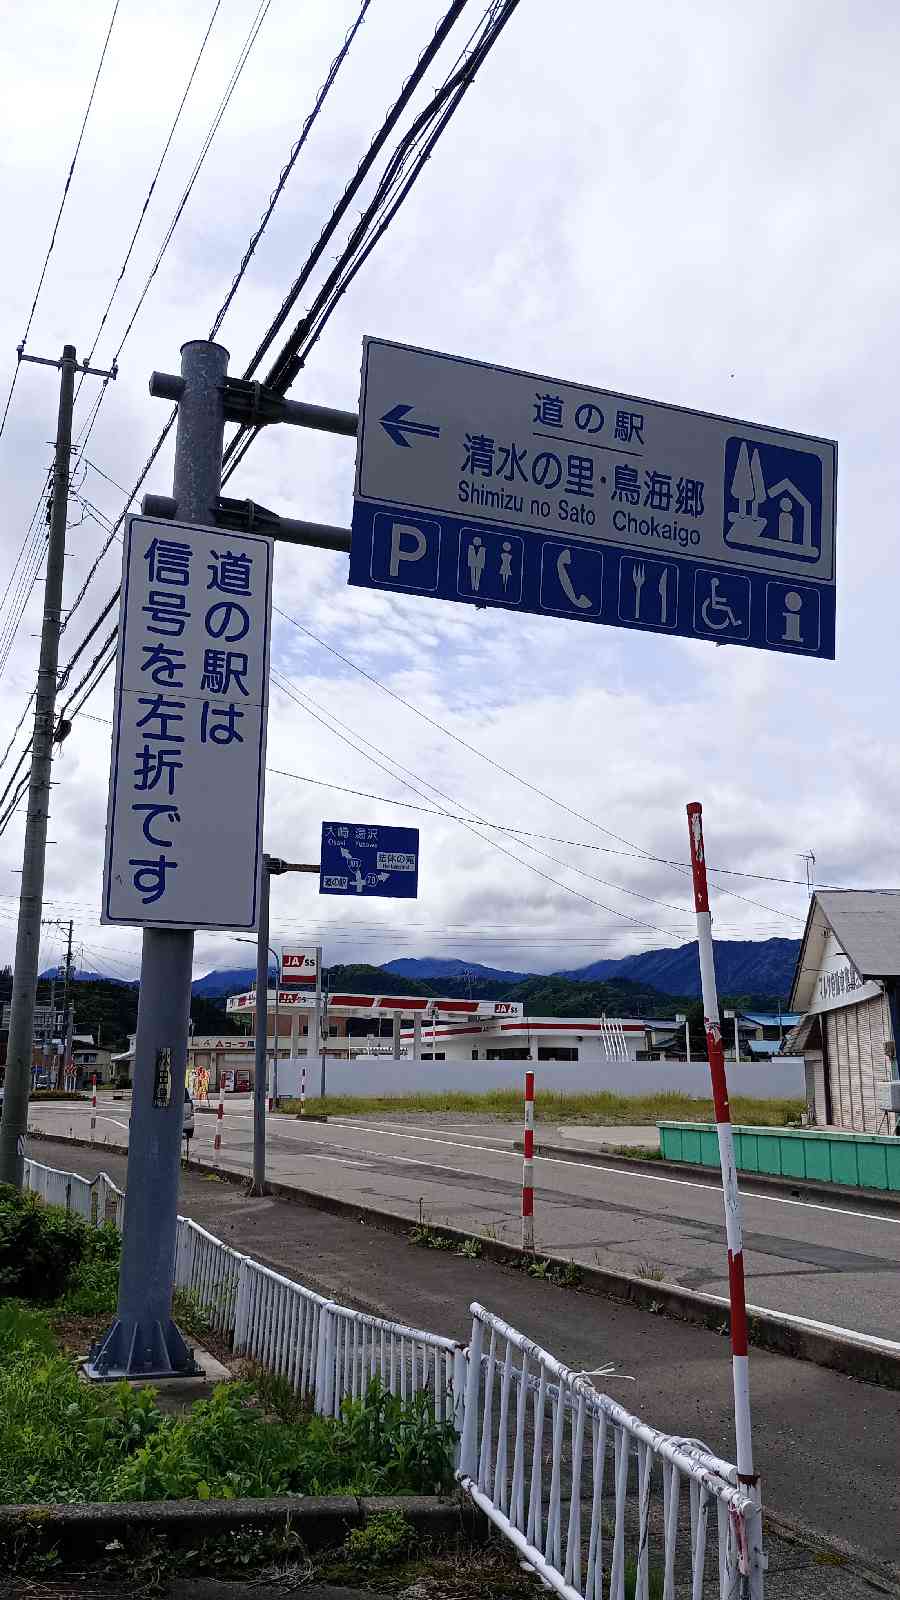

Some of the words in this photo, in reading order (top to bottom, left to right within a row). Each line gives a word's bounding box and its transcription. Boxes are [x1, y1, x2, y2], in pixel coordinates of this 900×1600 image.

[532, 392, 645, 446] 道の駅
[460, 432, 705, 518] 清水の里・鳥海郷
[458, 480, 524, 512] Shimizu
[530, 500, 551, 518] no
[558, 500, 596, 526] Sato
[613, 510, 701, 547] Chokaigo
[200, 550, 253, 745] 道の駅は
[128, 537, 193, 905] 信号を左折です
[284, 956, 300, 967] JA
[495, 1004, 507, 1013] JA
